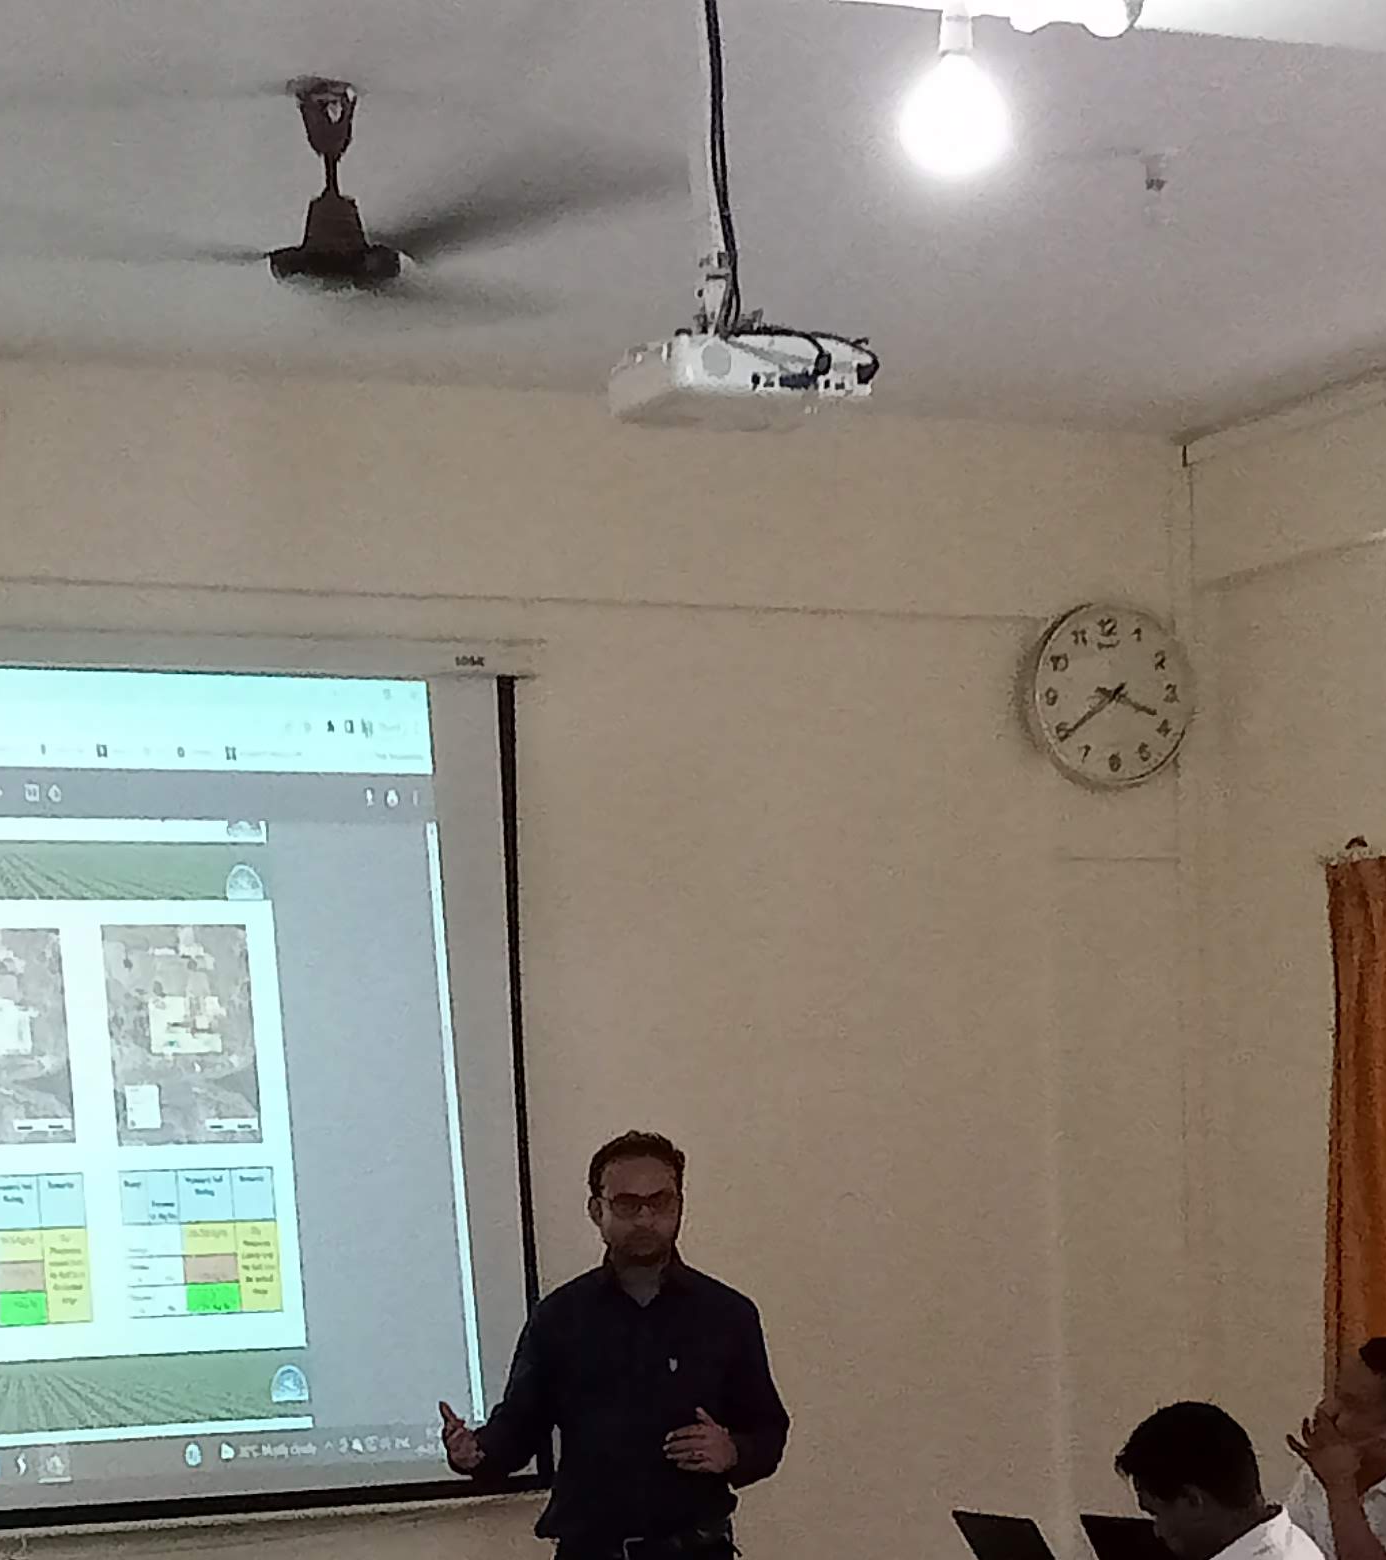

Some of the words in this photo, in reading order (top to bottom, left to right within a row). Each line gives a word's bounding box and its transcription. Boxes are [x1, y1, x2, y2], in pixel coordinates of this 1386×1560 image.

[1097, 617, 1118, 636] 12
[1049, 653, 1070, 672] 10
[1154, 650, 1166, 670] 2
